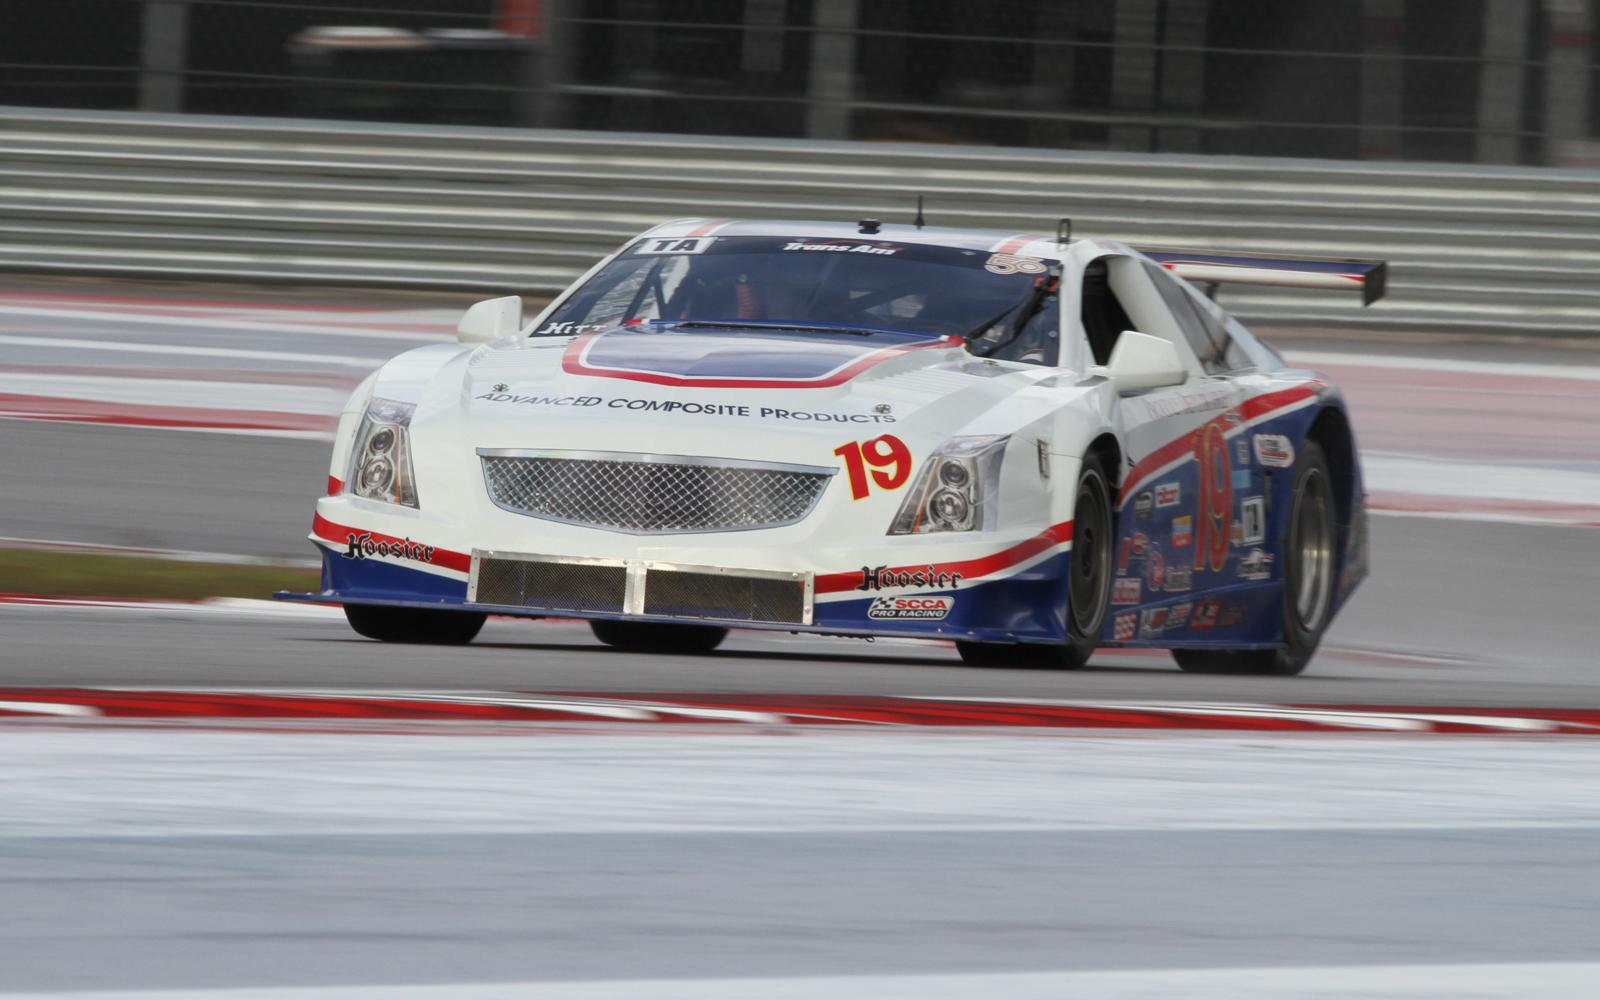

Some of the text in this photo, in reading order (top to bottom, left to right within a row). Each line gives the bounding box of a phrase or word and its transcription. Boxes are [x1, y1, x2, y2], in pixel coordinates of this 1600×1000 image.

[653, 239, 699, 251] TA
[783, 242, 897, 255] Trans Am
[476, 393, 897, 424] ADVANCED COMPOSITE PRODUCTS
[834, 433, 912, 501] 19
[1193, 423, 1233, 572] 19
[341, 532, 435, 562] Hoosier
[855, 564, 963, 591] Hoosier
[895, 599, 947, 609] SCCA
